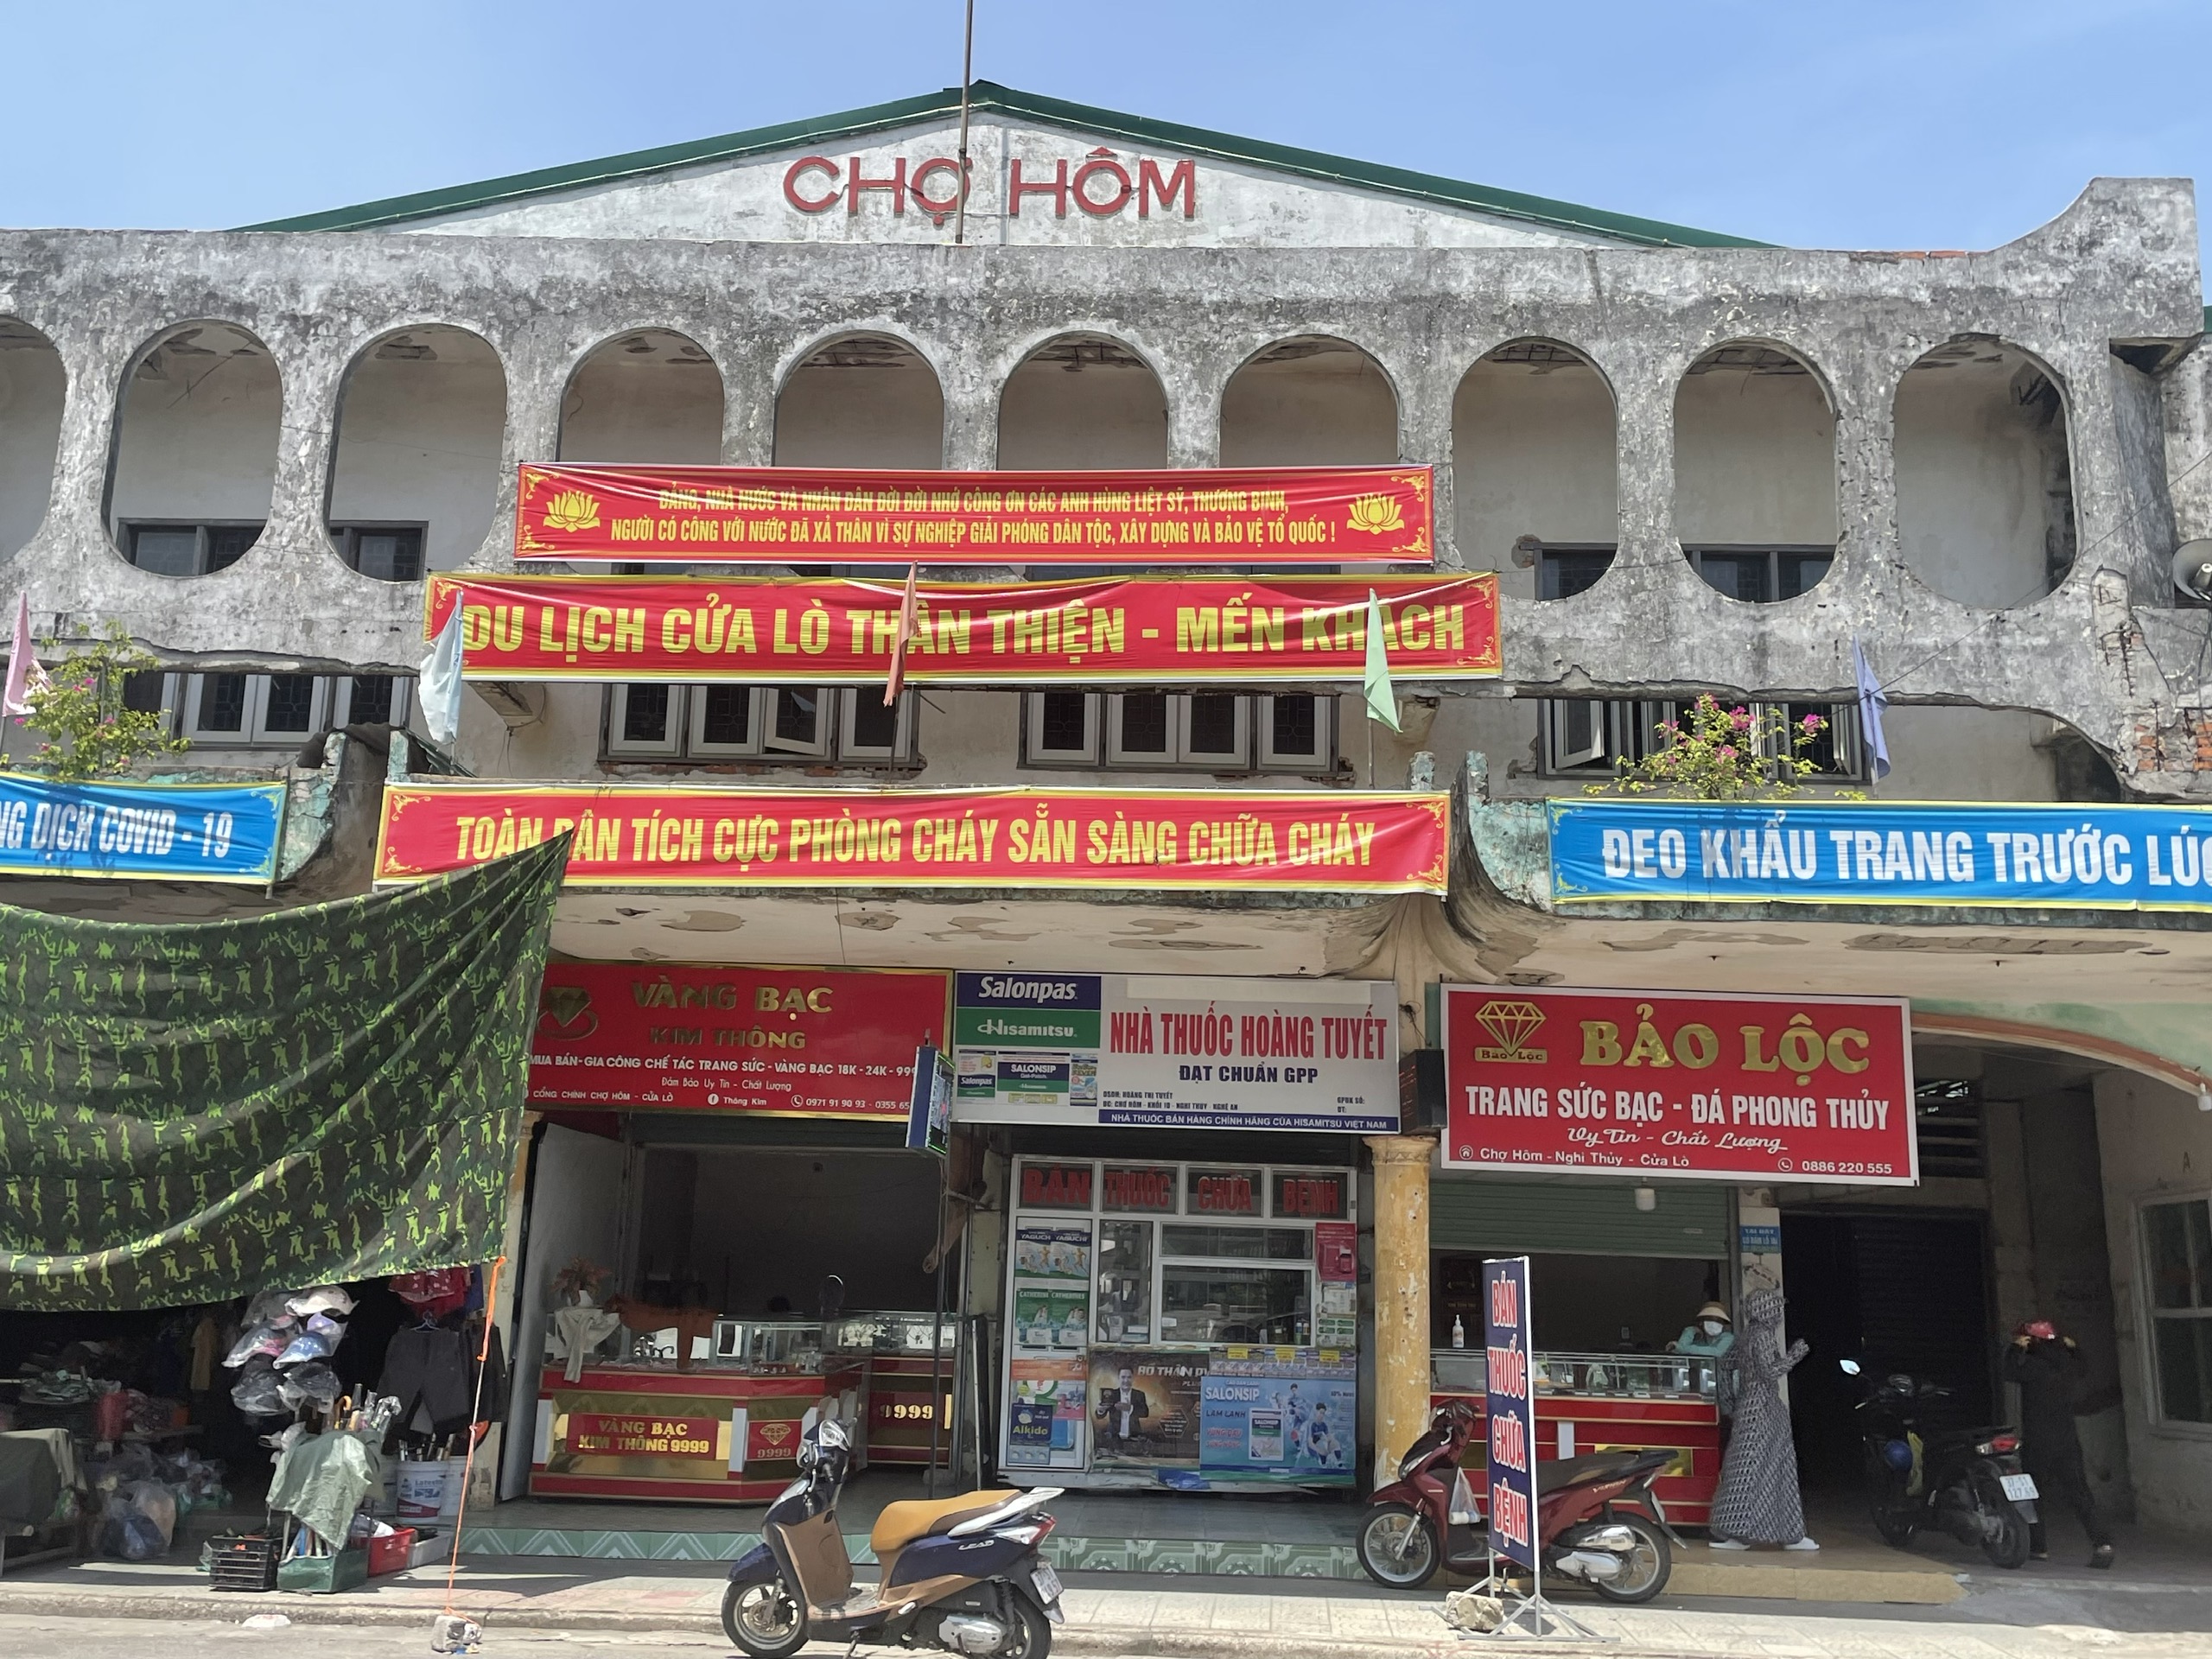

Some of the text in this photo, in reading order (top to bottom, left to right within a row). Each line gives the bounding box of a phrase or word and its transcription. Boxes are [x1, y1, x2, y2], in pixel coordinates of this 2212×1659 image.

[784, 147, 1195, 226] CHỢ HÔM
[780, 486, 798, 511] VÀ
[802, 486, 840, 512] NHÂN
[844, 486, 873, 512] DÂN
[931, 486, 960, 512] NHỚ
[963, 486, 1001, 512] CÔNG
[1005, 489, 1026, 512] ƠN
[1029, 486, 1057, 512] CÁC
[1060, 492, 1090, 512] ANH
[1093, 486, 1130, 512] HÙNG
[1135, 488, 1163, 517] LIỆT
[1192, 489, 1247, 513] THƯƠNG
[611, 513, 1326, 548] NGƯỜI CÓ CÔNG VỚI NƯỚC ĐÃ XẢ THÂN VÌ SỰ NGHIỆP GIẢI PHÓNG DÂN TỘC, XÂY DỰNG VÀ BẢO VỆ TỔ QUỐC
[463, 605, 524, 652] DU
[539, 607, 645, 662] LỊCH
[662, 593, 757, 654] CỬA
[773, 599, 830, 654] LÒ
[987, 599, 1124, 664] THIỆN
[1176, 592, 1286, 652] MẾN
[31, 803, 233, 861] DỊCH COVID 19
[456, 808, 543, 860] TOÀN
[631, 809, 702, 862] TÍCH
[713, 814, 778, 872] CỰC
[790, 808, 901, 863] PHÒNG
[912, 810, 996, 863] CHÁY
[1007, 803, 1077, 863] SẴN
[1087, 810, 1177, 866] SÀNG
[1188, 814, 1277, 866] CHỮA
[1287, 812, 1375, 867] CHÁY
[1601, 829, 1685, 879] ĐEO
[1700, 809, 1816, 880] KHẨU
[1829, 830, 1974, 882] TRANG
[1986, 823, 2133, 886] TRƯỚC
[632, 975, 834, 1021] VÀNG BẠC
[978, 976, 1077, 1003] Salonpas
[650, 1025, 806, 1050] KIM THÔNG
[977, 1019, 1074, 1037] Hisamitsu
[1110, 1001, 1388, 1060] NHÀ THUỐC HOÀNG TUYẾT
[1579, 1003, 1870, 1086] BẢO LỘC
[607, 1055, 641, 1068] CÔNG
[645, 1053, 671, 1069] CHẾ
[672, 1056, 695, 1070] TÁC
[699, 1059, 738, 1071] TRANG
[741, 1058, 765, 1072] SỨC
[775, 1058, 806, 1073] VÀNG
[810, 1065, 833, 1077] BẠC
[838, 1065, 856, 1075] 18K
[865, 1065, 887, 1076] 24K
[1011, 1064, 1057, 1073] SALONSIP
[1179, 1061, 1318, 1084] ĐẠT CHUẨN GPP
[533, 1086, 557, 1098] CỔNG
[612, 1090, 630, 1100] HÔM
[662, 1091, 673, 1102] LÒ
[703, 1079, 715, 1090] Uy
[806, 1098, 826, 1107] 0971
[842, 1099, 852, 1108] 90
[875, 1101, 896, 1109] 0355
[1465, 1082, 1889, 1130] TRANG SỨC BẠC ĐÁ PHONG THỦY
[1111, 1113, 1130, 1122] NHÀ
[1133, 1113, 1163, 1122] THUỐC
[1166, 1114, 1184, 1123] BÁN
[1187, 1115, 1212, 1124] HÀNG
[1215, 1115, 1243, 1125] CHÍNH
[1294, 1118, 1341, 1128] HISAMITSU
[1344, 1120, 1363, 1129] VIỆT
[1567, 1128, 1604, 1149] Uy
[1662, 1129, 1710, 1147] Chất
[1480, 1147, 1689, 1166] Chợ Hôm Nghi Thủy Cửa Lò
[1802, 1161, 1892, 1174] 0886 220 555
[1023, 1163, 1090, 1204] BÁN
[1104, 1166, 1171, 1207] THUỐC
[1491, 1270, 1517, 1328] BÁN
[1487, 1333, 1526, 1402] THUỐC
[1205, 1386, 1260, 1402] SALONSIP
[880, 1404, 933, 1420] 9999
[598, 1417, 688, 1439] VÀNG BẠC
[1013, 1426, 1048, 1435] Alkido
[579, 1434, 709, 1453] KIM THÔNG 9999
[757, 1447, 791, 1459] 9999
[1492, 1409, 1527, 1473] CHỮA
[1493, 1477, 1529, 1548] BỆNH
[958, 1539, 995, 1550] LEAD
